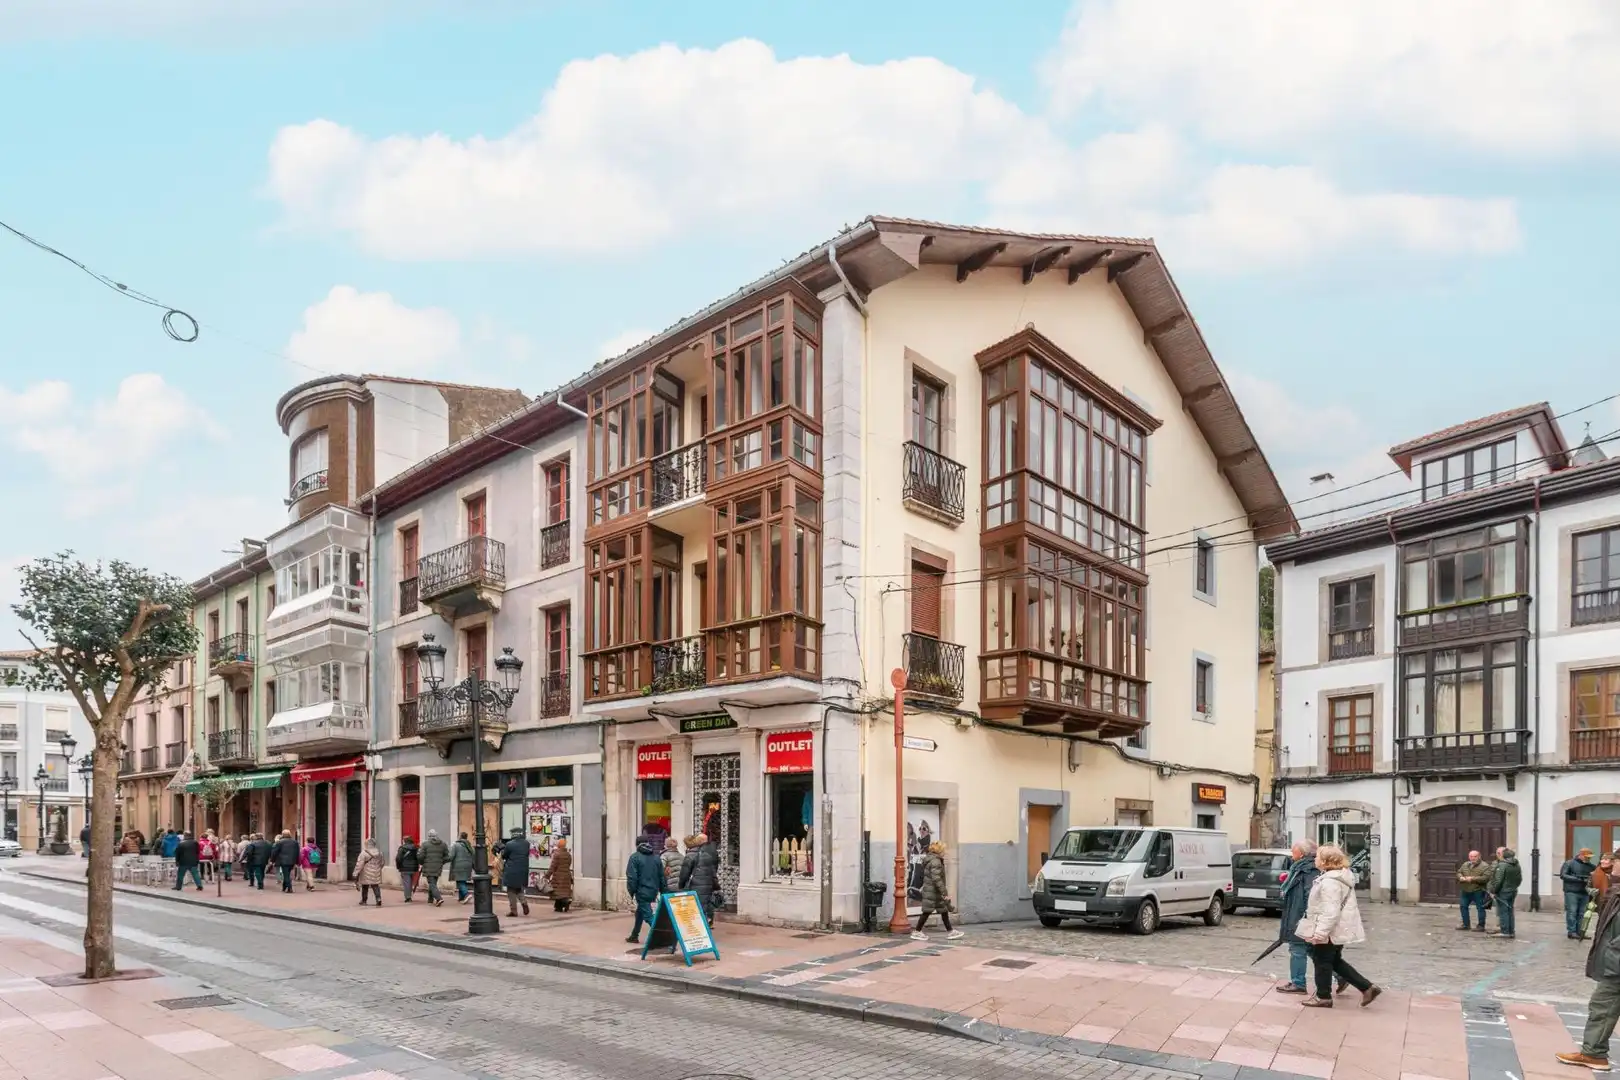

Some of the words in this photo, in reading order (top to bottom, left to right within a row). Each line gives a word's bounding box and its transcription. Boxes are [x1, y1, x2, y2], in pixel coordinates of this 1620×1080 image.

[685, 719, 712, 730] GREEN
[715, 716, 731, 727] DAY
[768, 740, 812, 752] OUTLET
[639, 750, 672, 761] OUTLET
